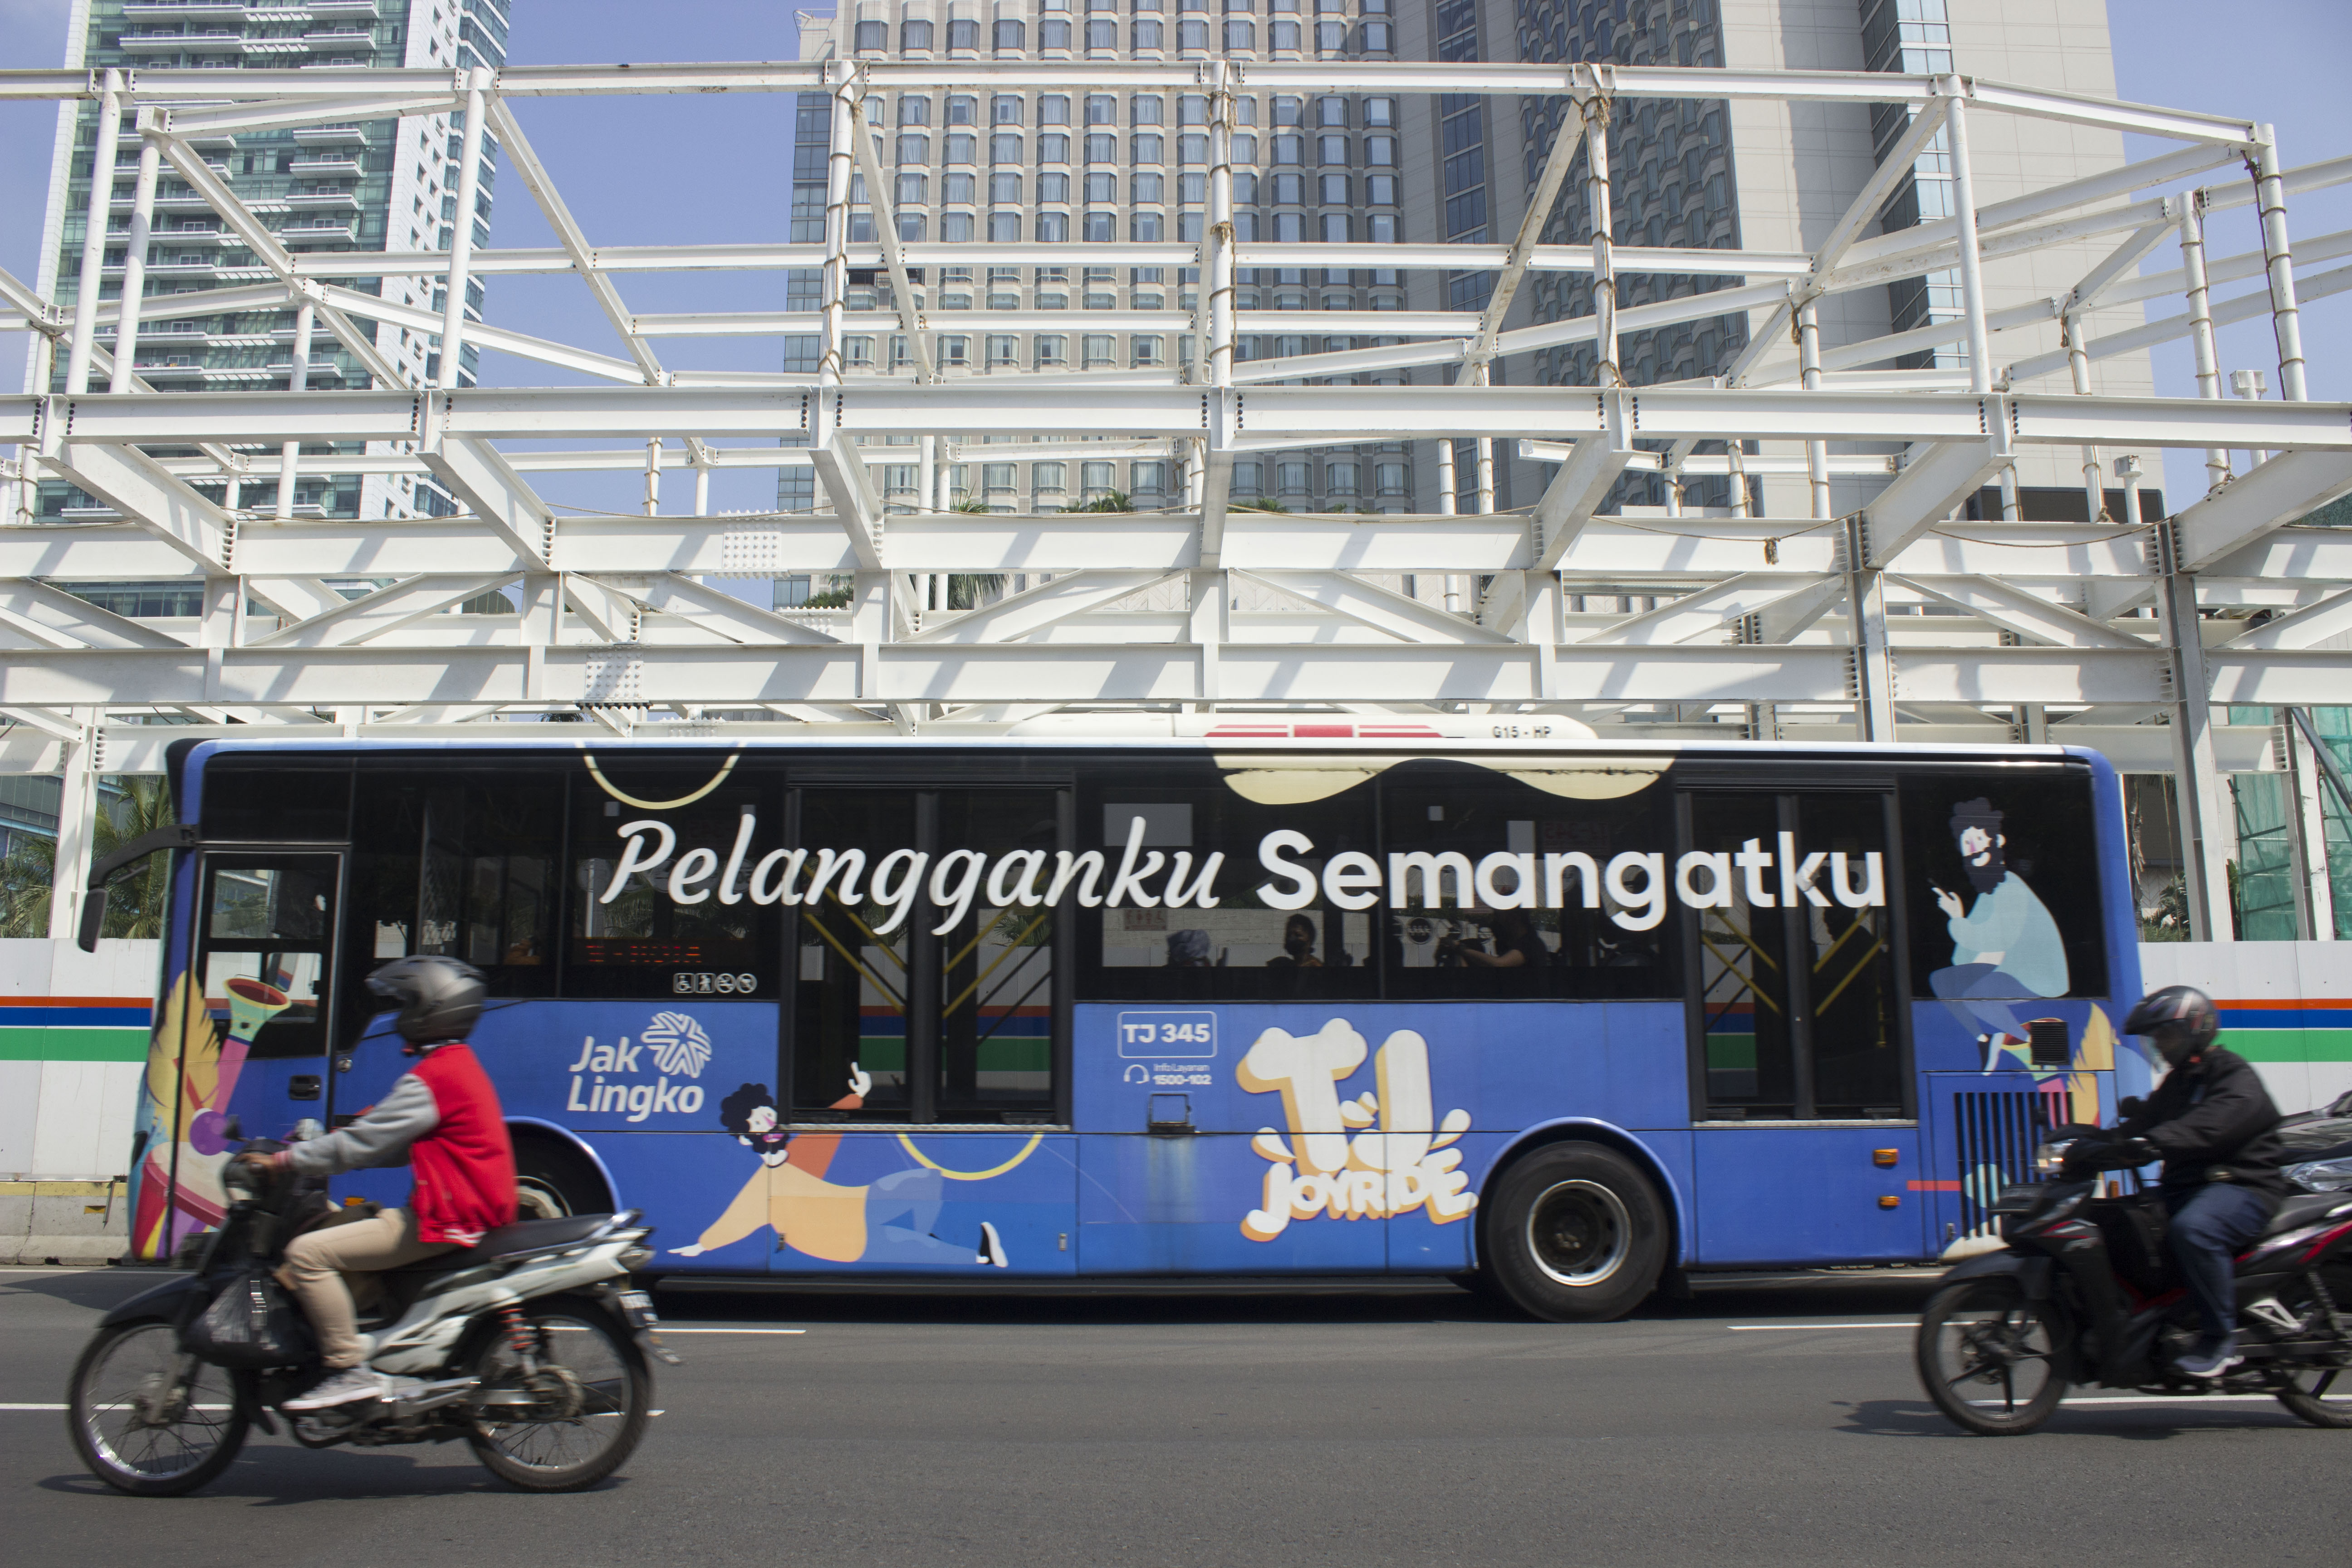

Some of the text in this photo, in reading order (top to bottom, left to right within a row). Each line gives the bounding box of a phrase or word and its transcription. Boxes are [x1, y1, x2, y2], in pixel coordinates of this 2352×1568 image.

[1492, 725, 1519, 739] G15
[1533, 725, 1551, 739] HP
[599, 813, 1885, 936] Pelangganku Semangatku
[568, 1036, 643, 1073] Jak
[1122, 1024, 1211, 1043] TJ 345
[567, 1075, 705, 1122] Lingko
[1152, 1074, 1212, 1085] 1500-102
[1235, 1018, 1433, 1180] TJ
[1240, 1148, 1479, 1242] JOYRIDE
